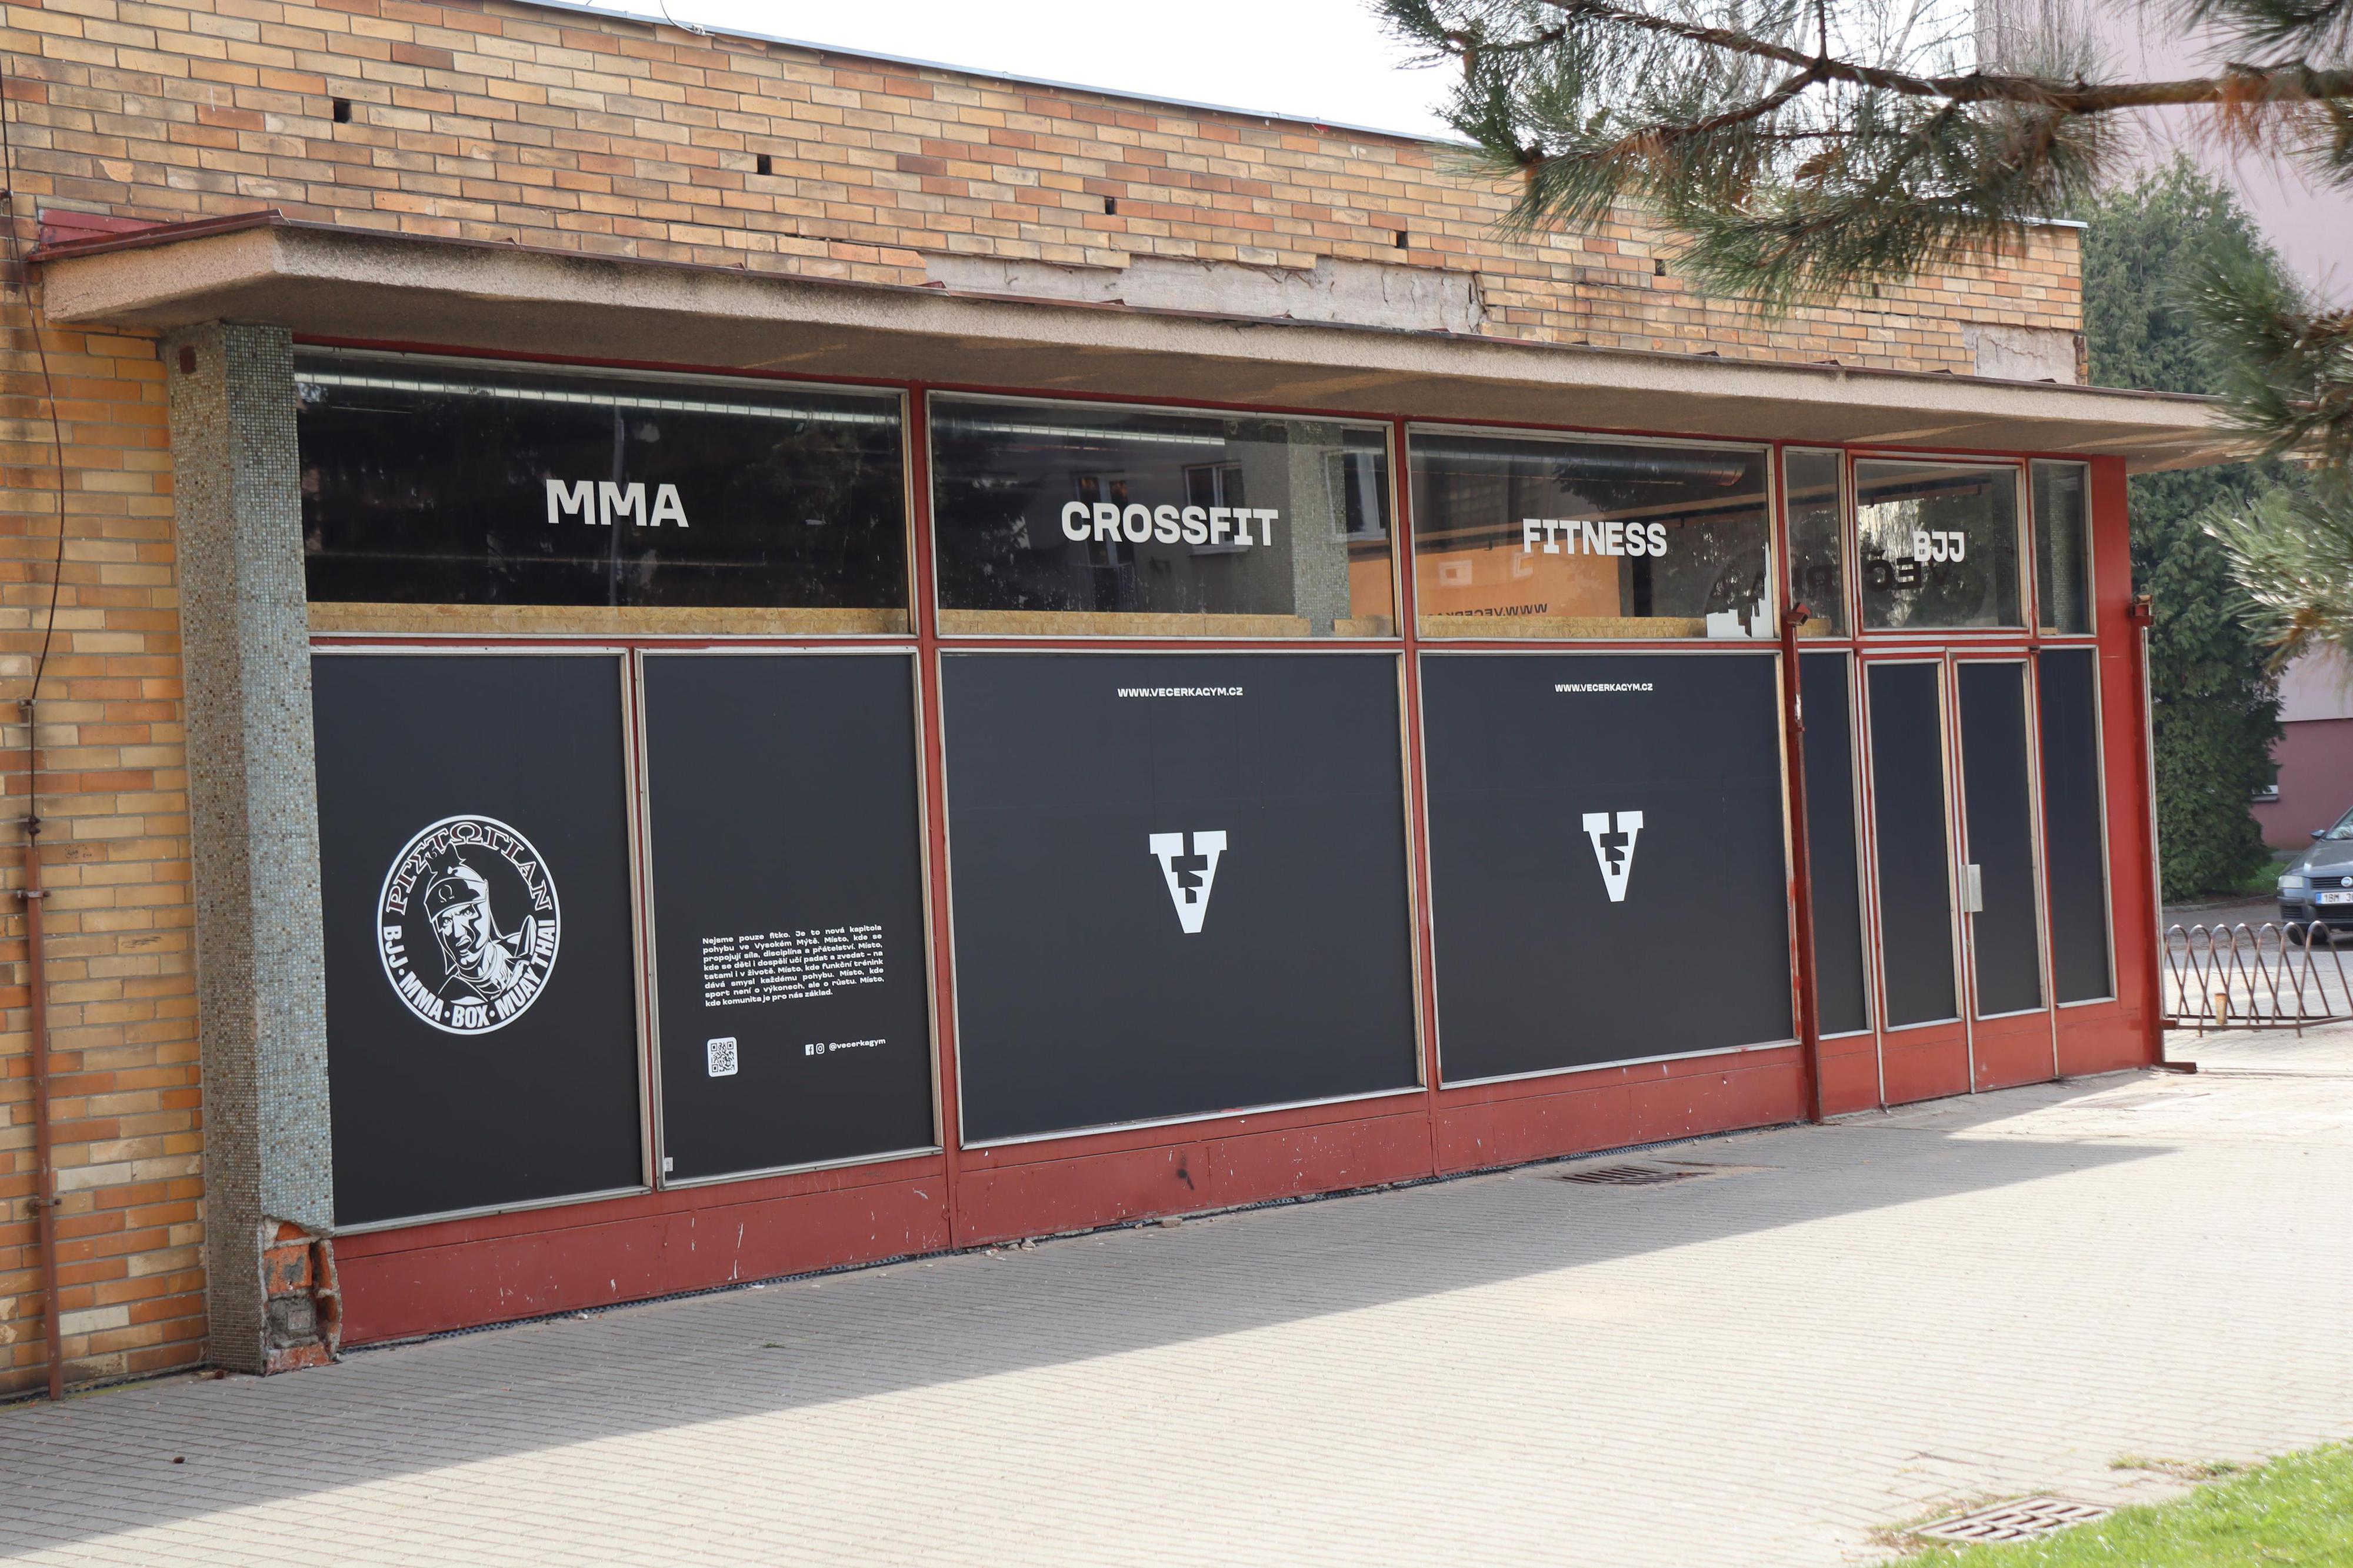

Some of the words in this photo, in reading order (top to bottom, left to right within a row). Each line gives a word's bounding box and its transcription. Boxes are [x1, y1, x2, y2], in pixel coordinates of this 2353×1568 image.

[546, 479, 688, 527] MMA
[1062, 502, 1278, 546] CROSSFIT
[1523, 518, 1667, 557] FITNESS
[1913, 531, 1965, 563] BJJ
[1117, 687, 1244, 698] WWW.VECERKAGYM.CZ
[1554, 683, 1653, 692] WWW.VECERKAGYM.CZ
[702, 936, 734, 945] Nejsme
[739, 935, 764, 943] pouze
[849, 925, 882, 933] kapitola
[703, 945, 734, 955] pohybu
[754, 940, 792, 950] Vysokém
[796, 938, 819, 946] Mýtě.
[704, 953, 741, 963] propojují
[764, 947, 801, 957] disciplína
[812, 943, 855, 954] přátelství.
[704, 971, 733, 980] tatami
[748, 968, 775, 976] životě.
[822, 960, 852, 969] funkční
[854, 958, 883, 966] trénink
[734, 960, 751, 969] děti
[758, 958, 787, 966] dospělí
[804, 955, 828, 963] padat
[384, 924, 408, 969] BJJ
[398, 971, 444, 1022] MMA
[451, 1003, 490, 1028] BOX
[496, 970, 542, 1020] MUAY
[532, 919, 556, 972] THAI
[731, 978, 755, 987] smysl
[761, 975, 797, 983] každému
[803, 972, 834, 981] pohybu.
[705, 990, 730, 999] sport
[764, 982, 805, 993] výkonech,
[722, 996, 762, 1005] komunita
[762, 995, 770, 1003] je
[805, 989, 833, 997] základ.
[829, 1038, 886, 1052] @vecerkagym
